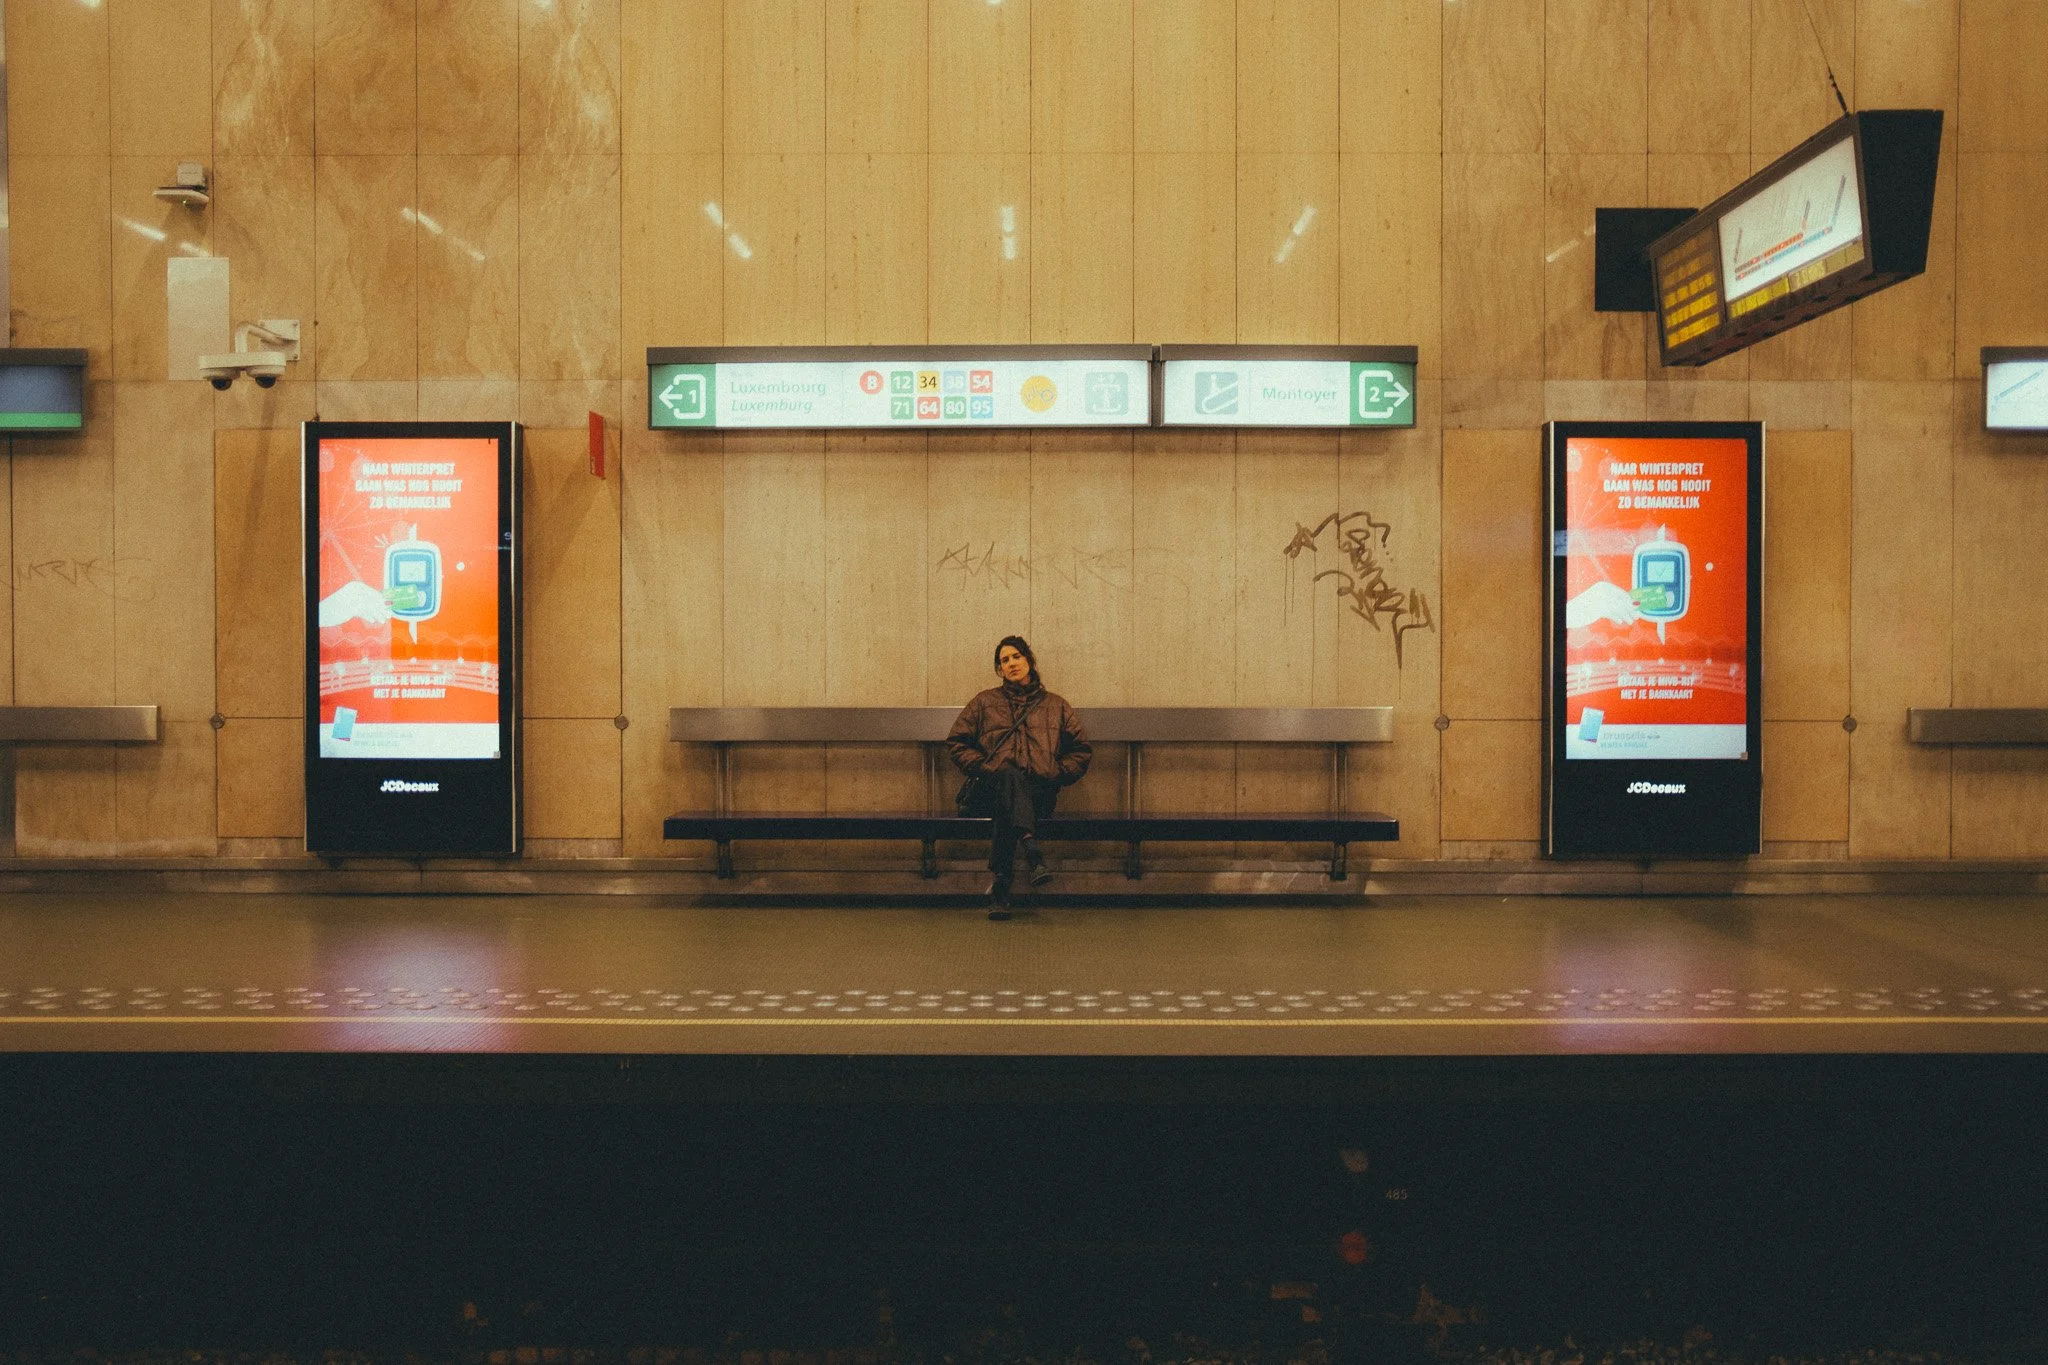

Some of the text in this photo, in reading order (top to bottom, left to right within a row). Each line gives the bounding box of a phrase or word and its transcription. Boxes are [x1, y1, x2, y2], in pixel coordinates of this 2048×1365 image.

[731, 381, 826, 396] Luxembourg
[867, 375, 878, 390] B
[893, 376, 911, 390] 12
[919, 375, 937, 389] 34
[973, 375, 992, 389] 54
[689, 389, 697, 404] 1
[1262, 387, 1337, 404] Montoyer
[1369, 386, 1380, 402] 2
[731, 399, 813, 414] Luxemburg
[893, 401, 991, 415] 71 64 80 95
[362, 462, 455, 475] NAAR WINTERPRET
[1610, 462, 1704, 475] NAAR WINTERPRET
[1603, 479, 1712, 492] GAAN WAS NOG NOOIT
[369, 496, 383, 509] ZO
[1617, 496, 1700, 509] ZO GEMAKKELIJK
[1621, 689, 1694, 700] MET JE BANKKAART
[380, 780, 439, 792] JCDecaux
[1627, 782, 1686, 794] JCDecaux
